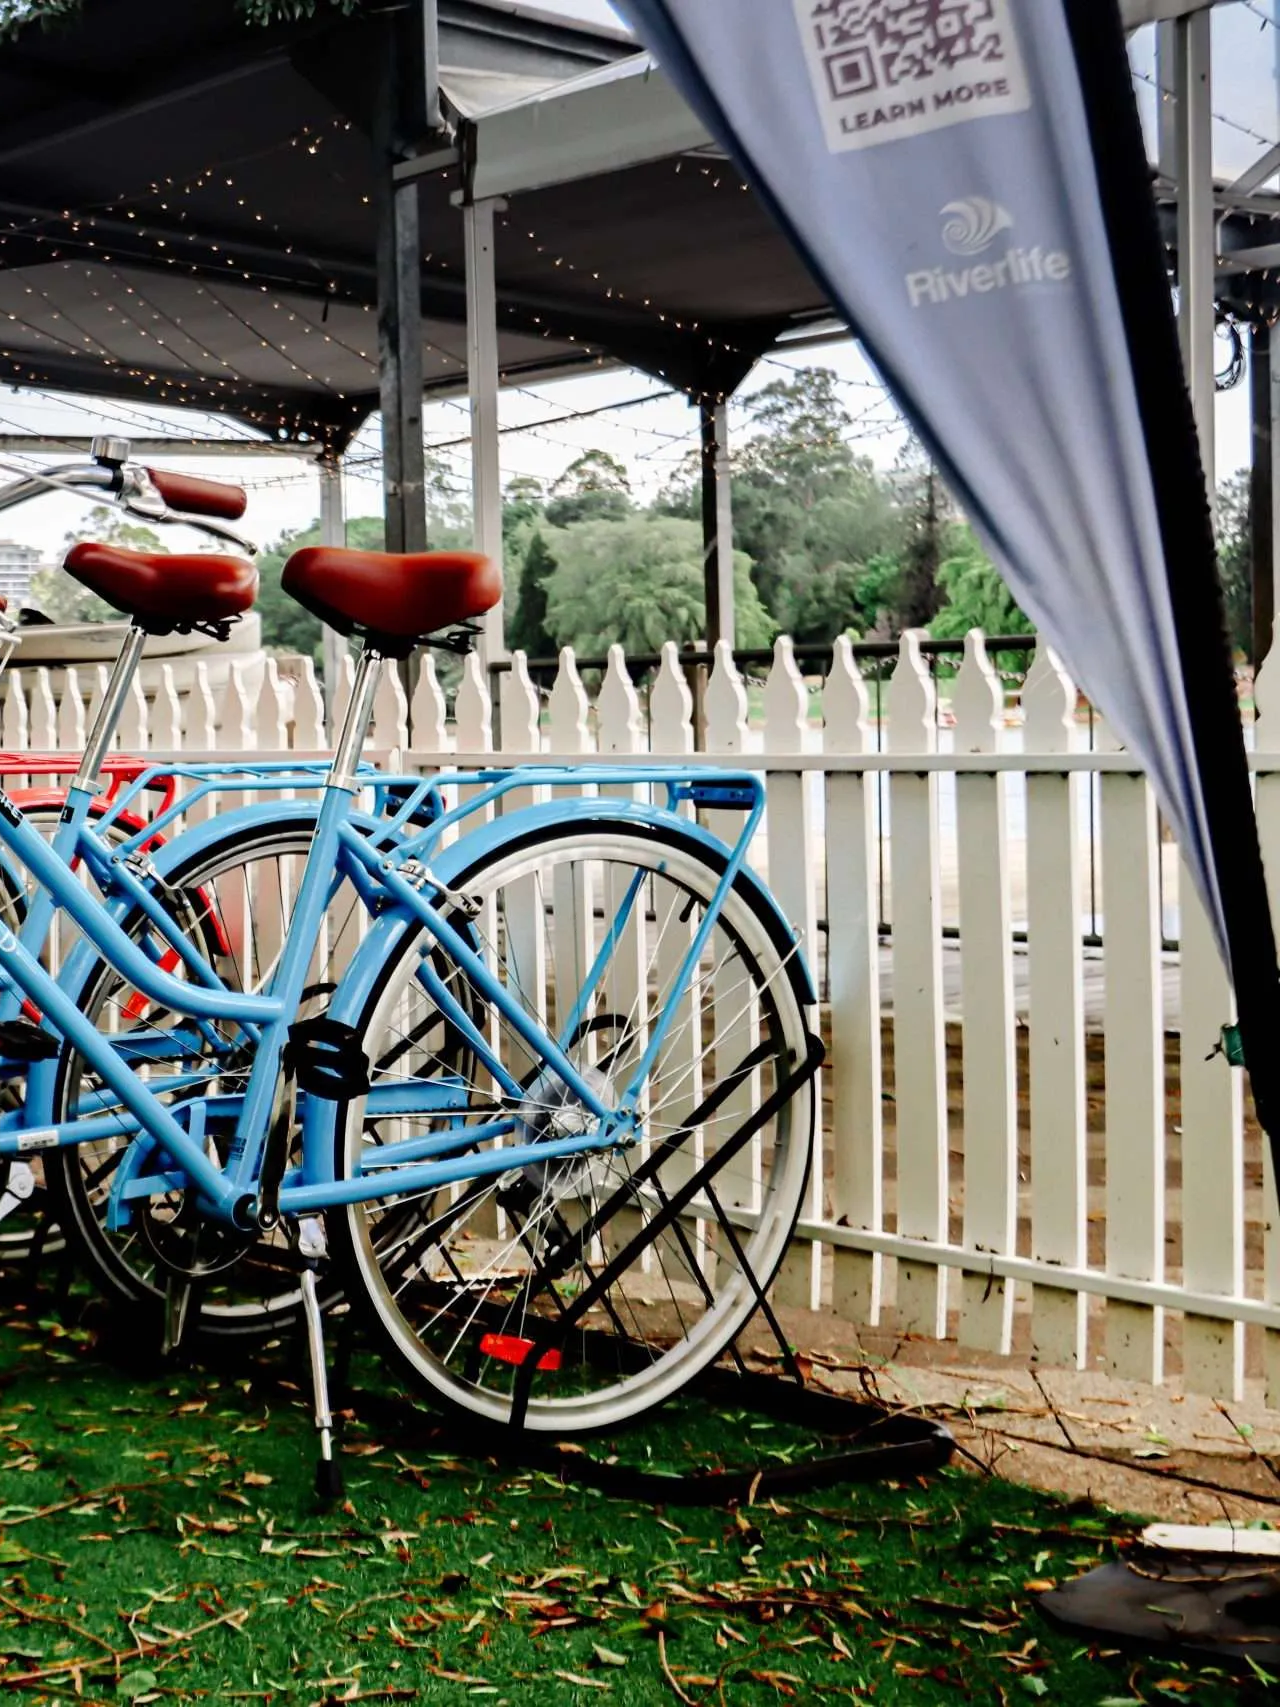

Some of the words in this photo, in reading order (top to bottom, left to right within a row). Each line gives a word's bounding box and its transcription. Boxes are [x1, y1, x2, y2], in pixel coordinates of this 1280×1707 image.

[840, 102, 926, 134] LEARN
[932, 78, 1010, 111] MORE
[905, 246, 1071, 306] Riverlife
